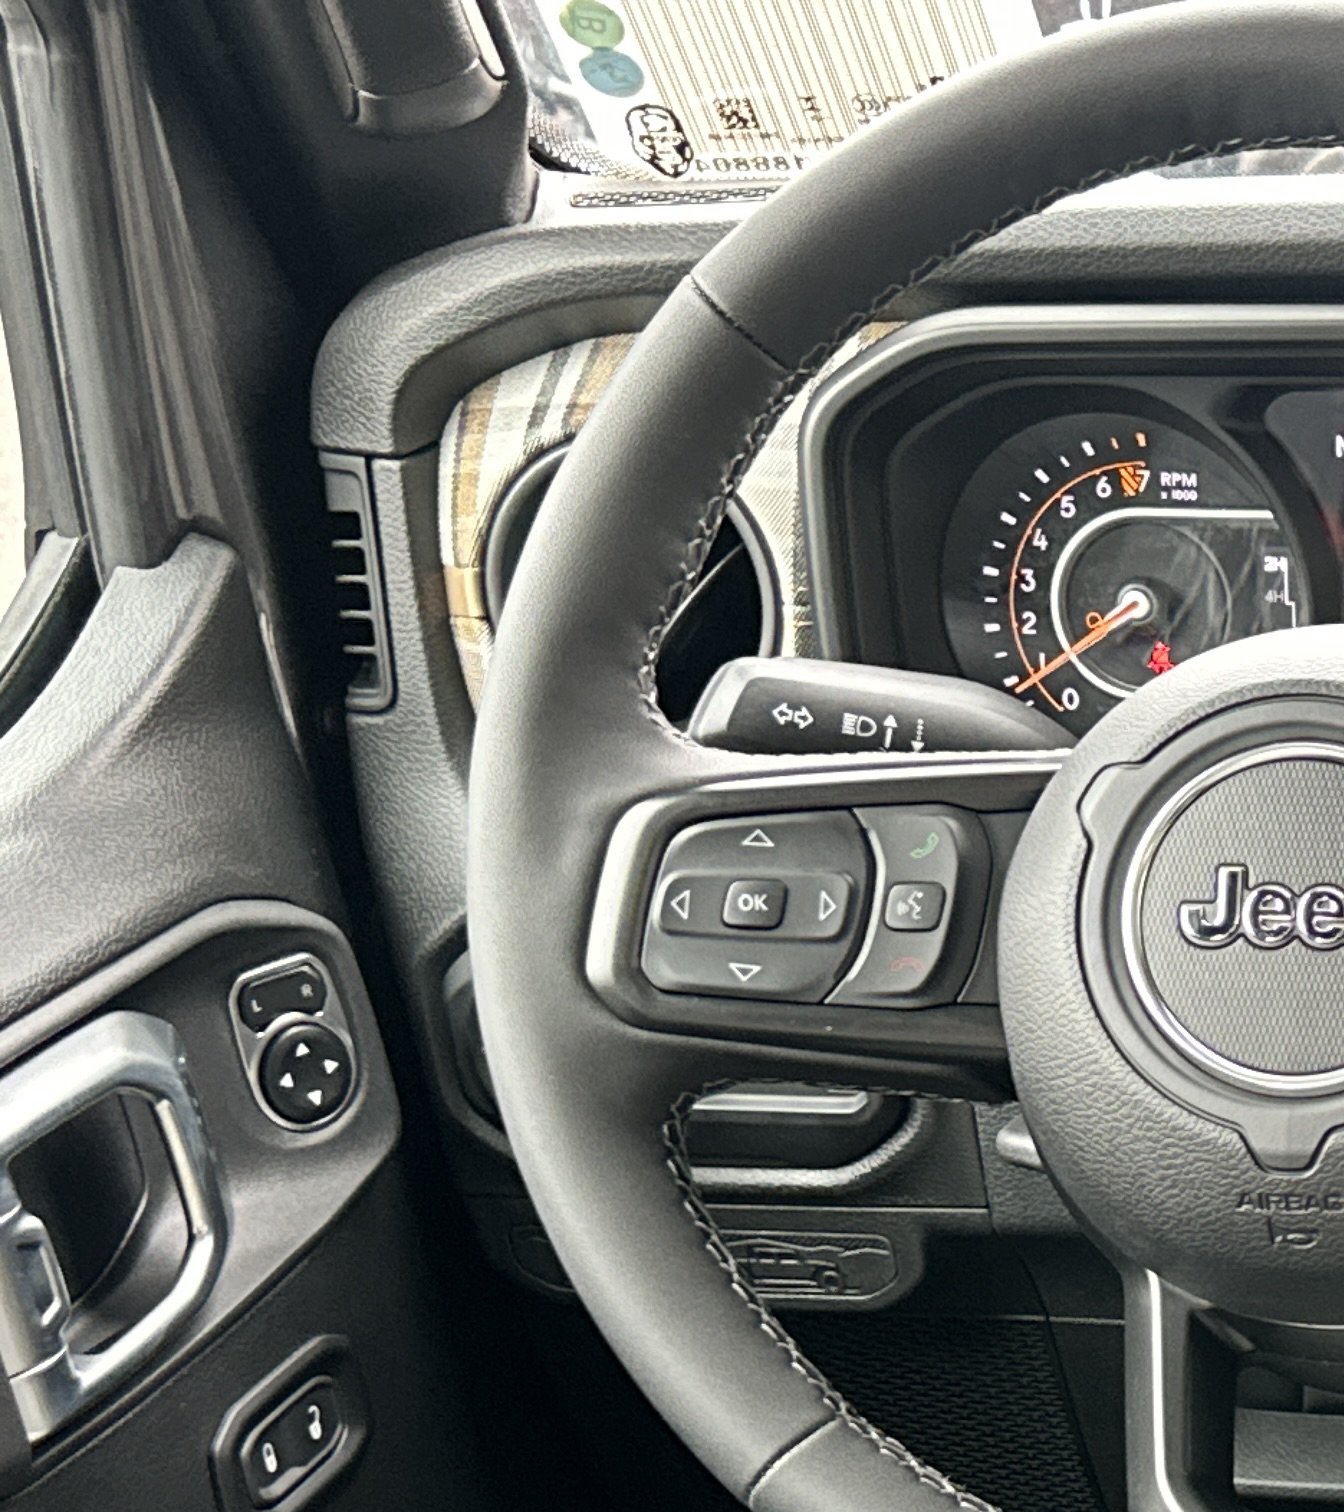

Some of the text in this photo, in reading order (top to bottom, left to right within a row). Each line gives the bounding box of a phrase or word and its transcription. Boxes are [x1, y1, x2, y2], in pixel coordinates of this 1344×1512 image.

[1096, 476, 1112, 498] 6
[1160, 471, 1198, 488] RPM
[1060, 496, 1076, 518] 5
[1032, 528, 1049, 550] 4
[1263, 555, 1286, 572] 2H
[1019, 569, 1037, 592] 3
[1264, 589, 1284, 603] 4H
[1021, 611, 1037, 635] 2
[1062, 688, 1080, 709] 0
[737, 892, 769, 912] OK
[300, 983, 314, 998] R
[250, 999, 264, 1013] L
